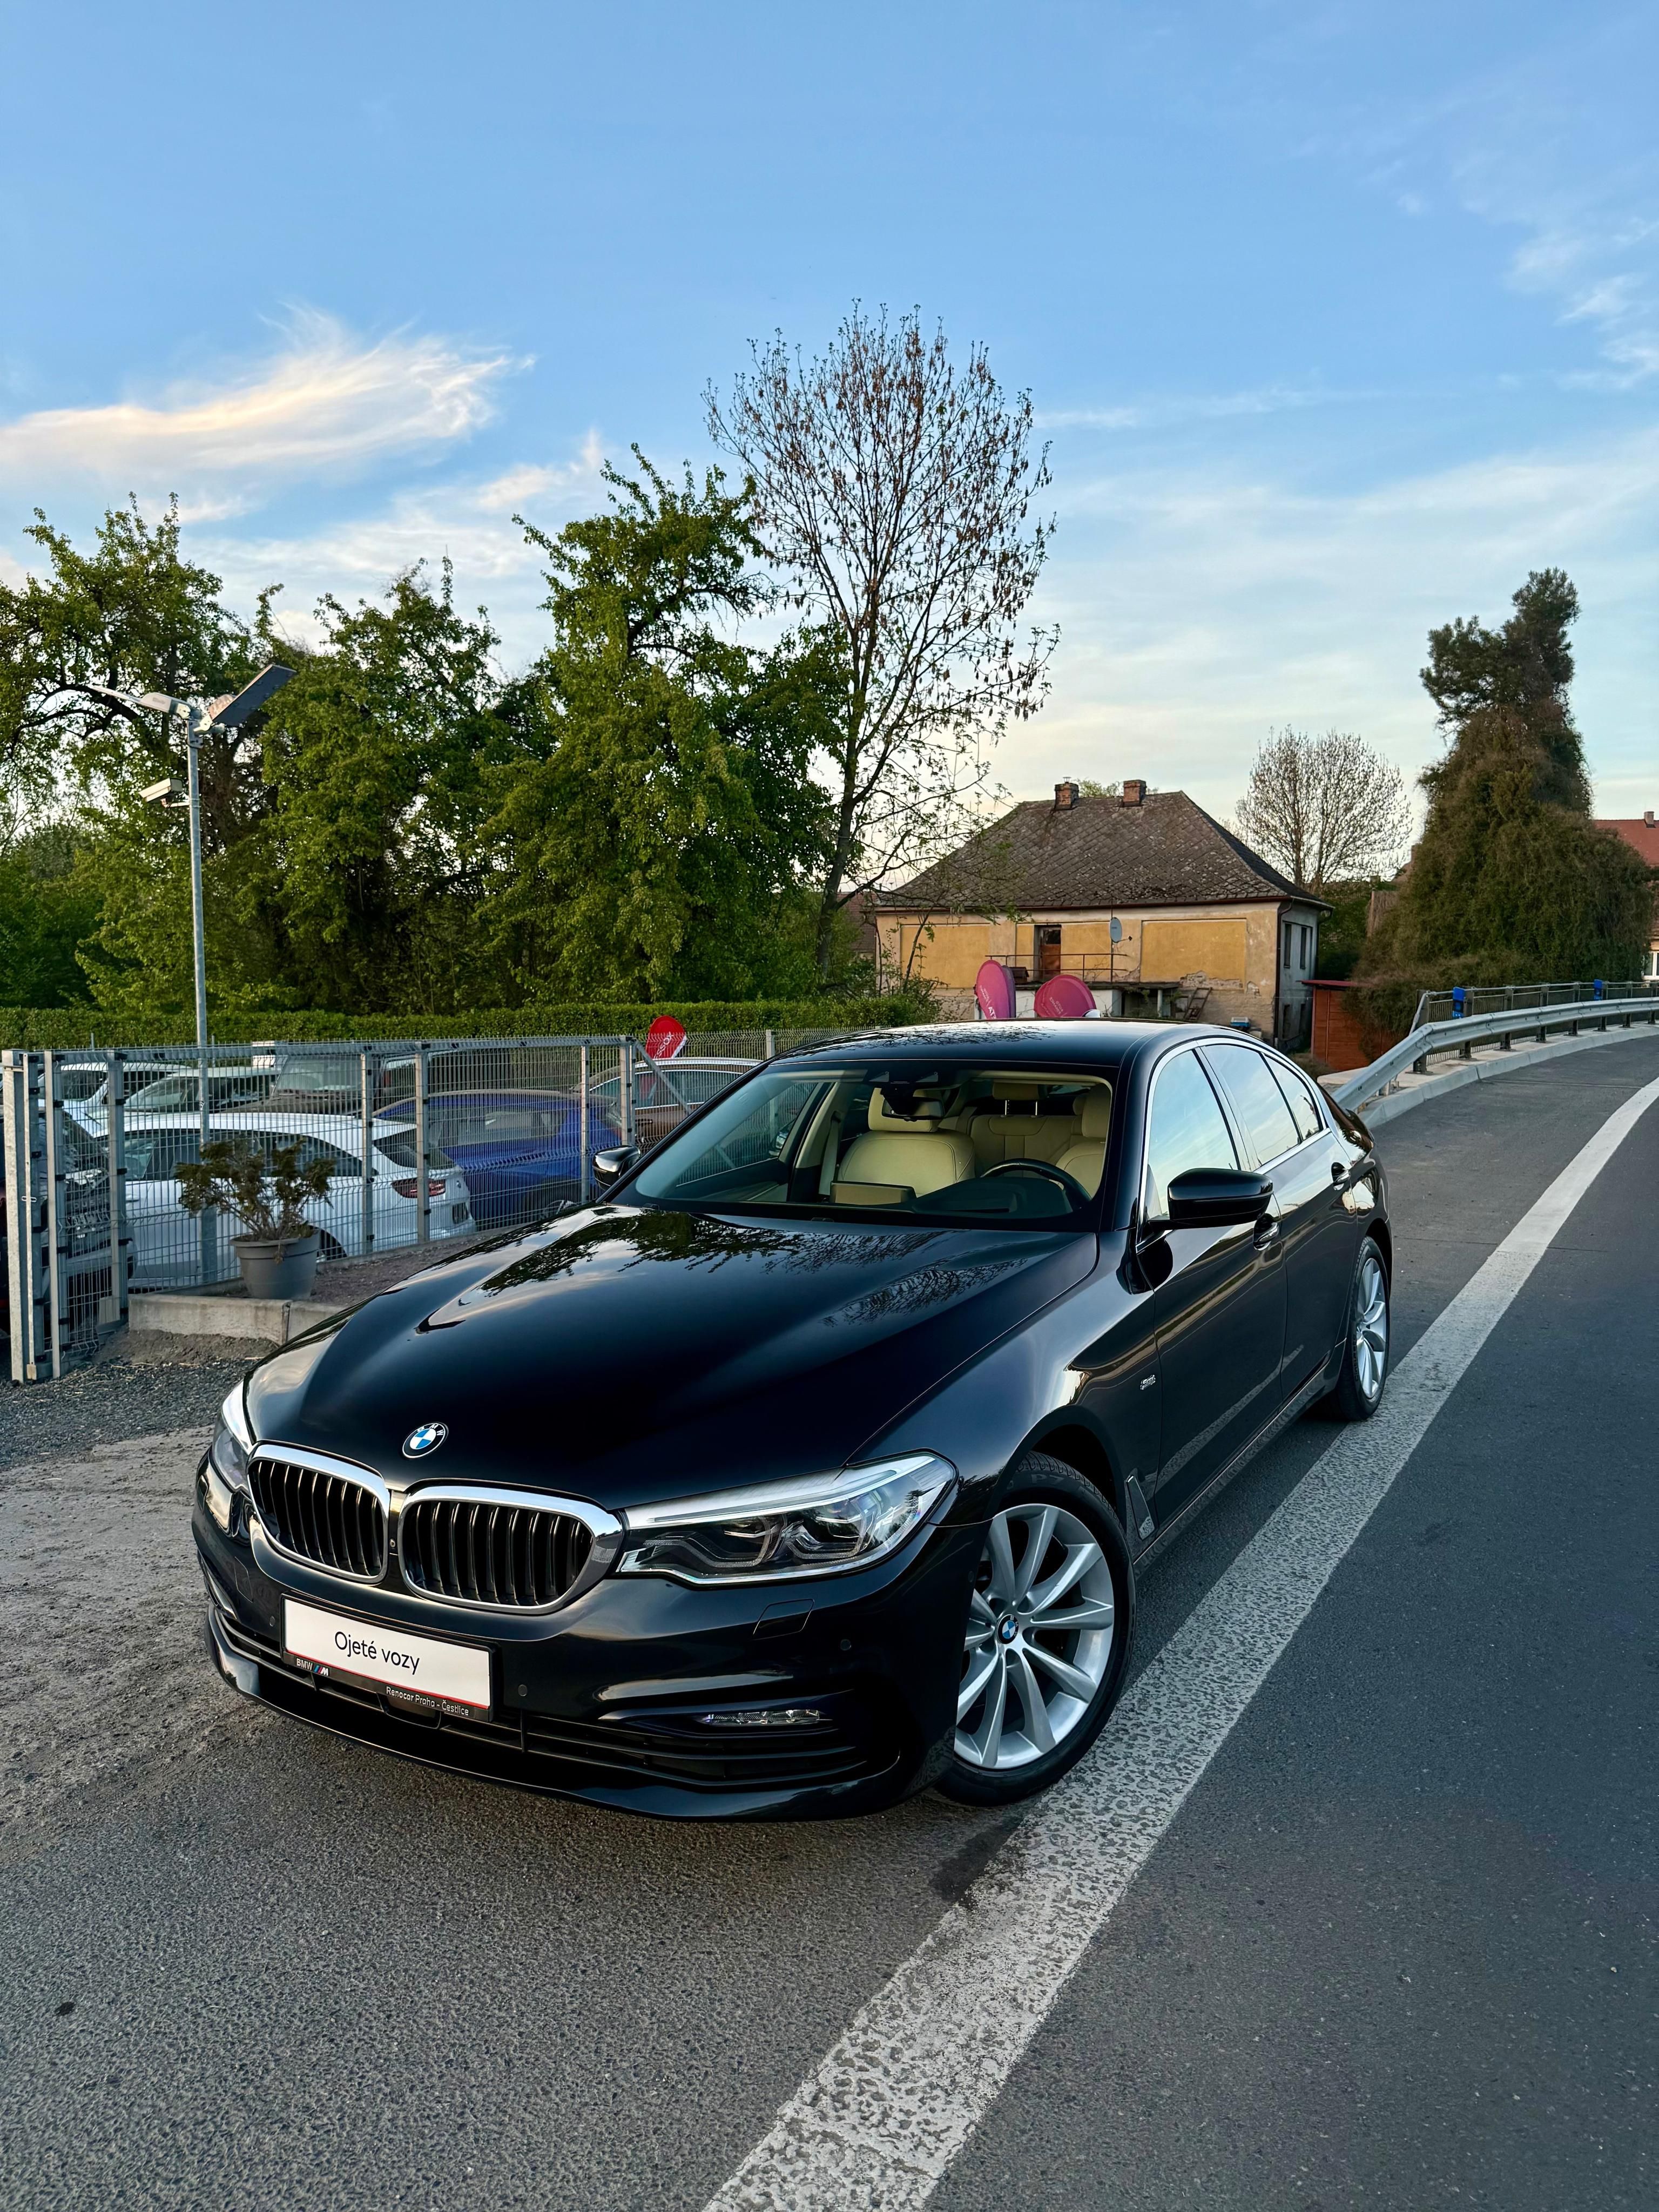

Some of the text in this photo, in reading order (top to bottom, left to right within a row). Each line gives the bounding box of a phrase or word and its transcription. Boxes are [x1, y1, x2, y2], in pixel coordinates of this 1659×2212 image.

[417, 1423, 444, 1436] BMW
[335, 1631, 420, 1675] Ojeté vozy
[296, 1658, 313, 1670] BMW
[386, 1686, 414, 1701] Renocar
[415, 1695, 435, 1708] Praha
[442, 1700, 469, 1716] Čestlice
